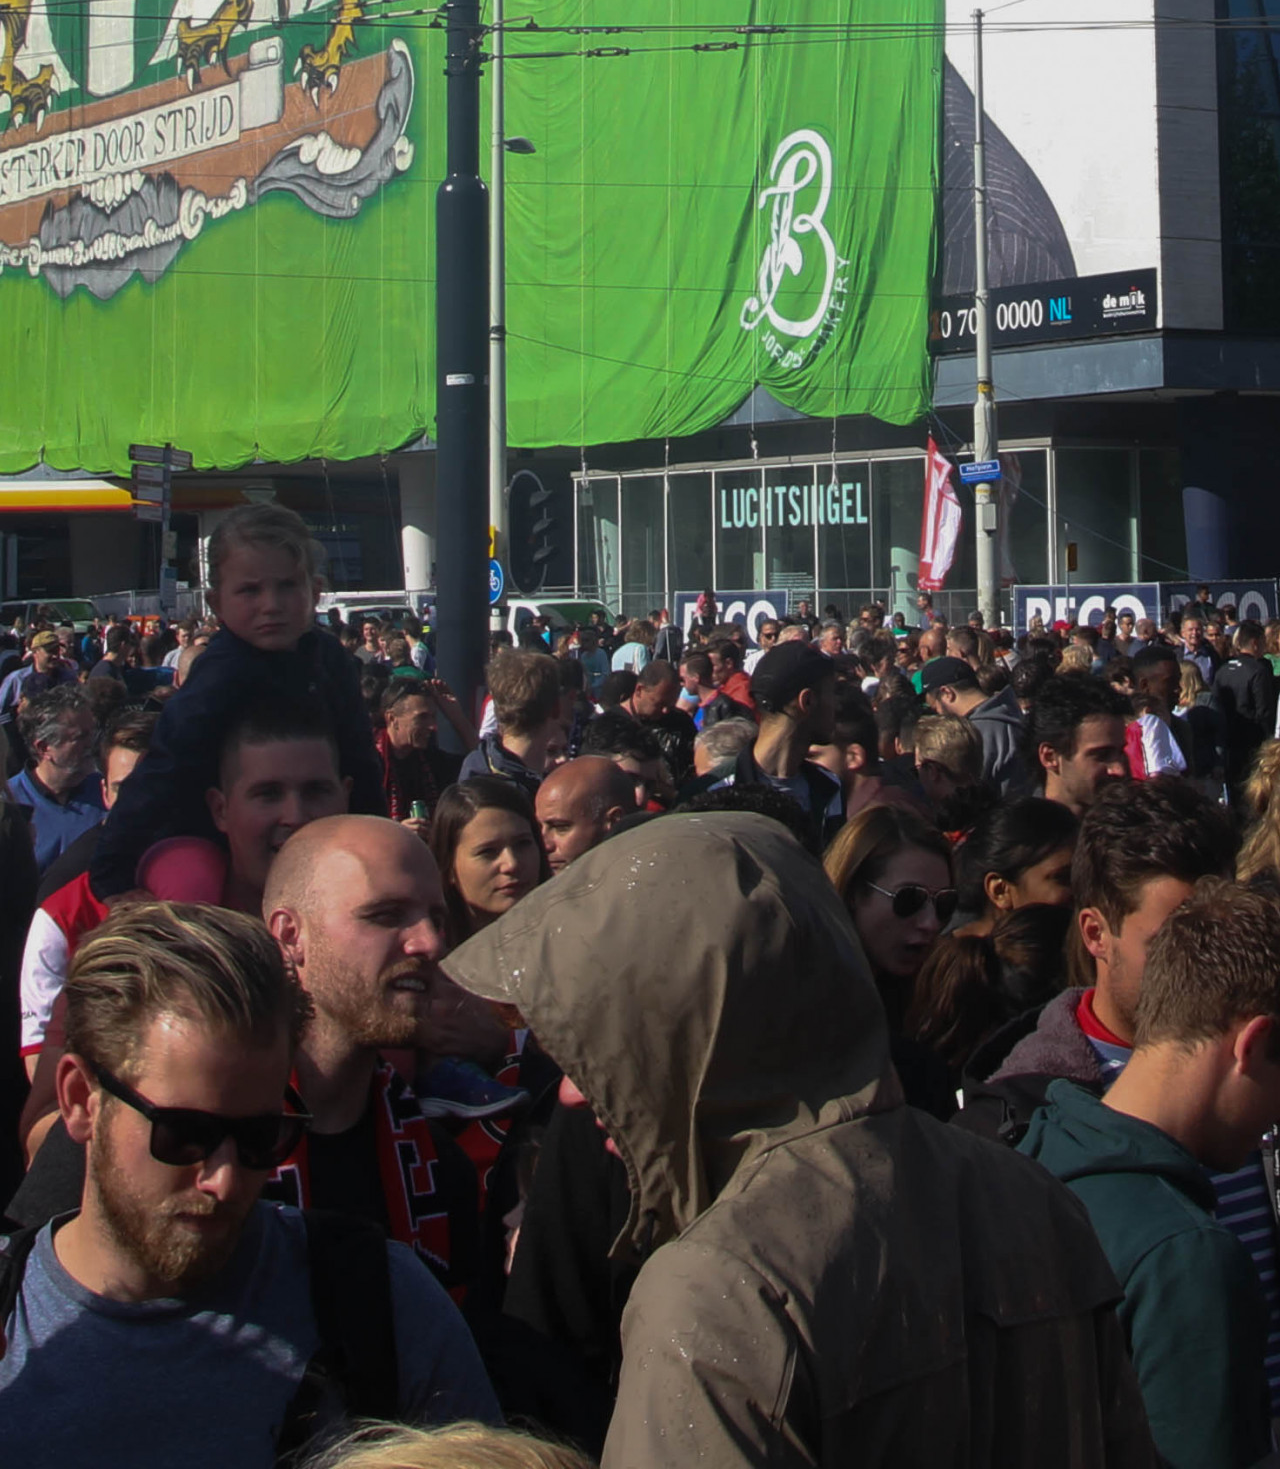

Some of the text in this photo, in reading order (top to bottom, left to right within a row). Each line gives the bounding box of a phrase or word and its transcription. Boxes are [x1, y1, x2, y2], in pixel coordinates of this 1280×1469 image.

[94, 122, 145, 171] DOOR
[154, 94, 235, 156] STRIJD
[996, 299, 1043, 331] 0000
[1049, 297, 1072, 321] NL
[1102, 294, 1117, 309] de
[721, 482, 868, 529] LUCHTSINGEL
